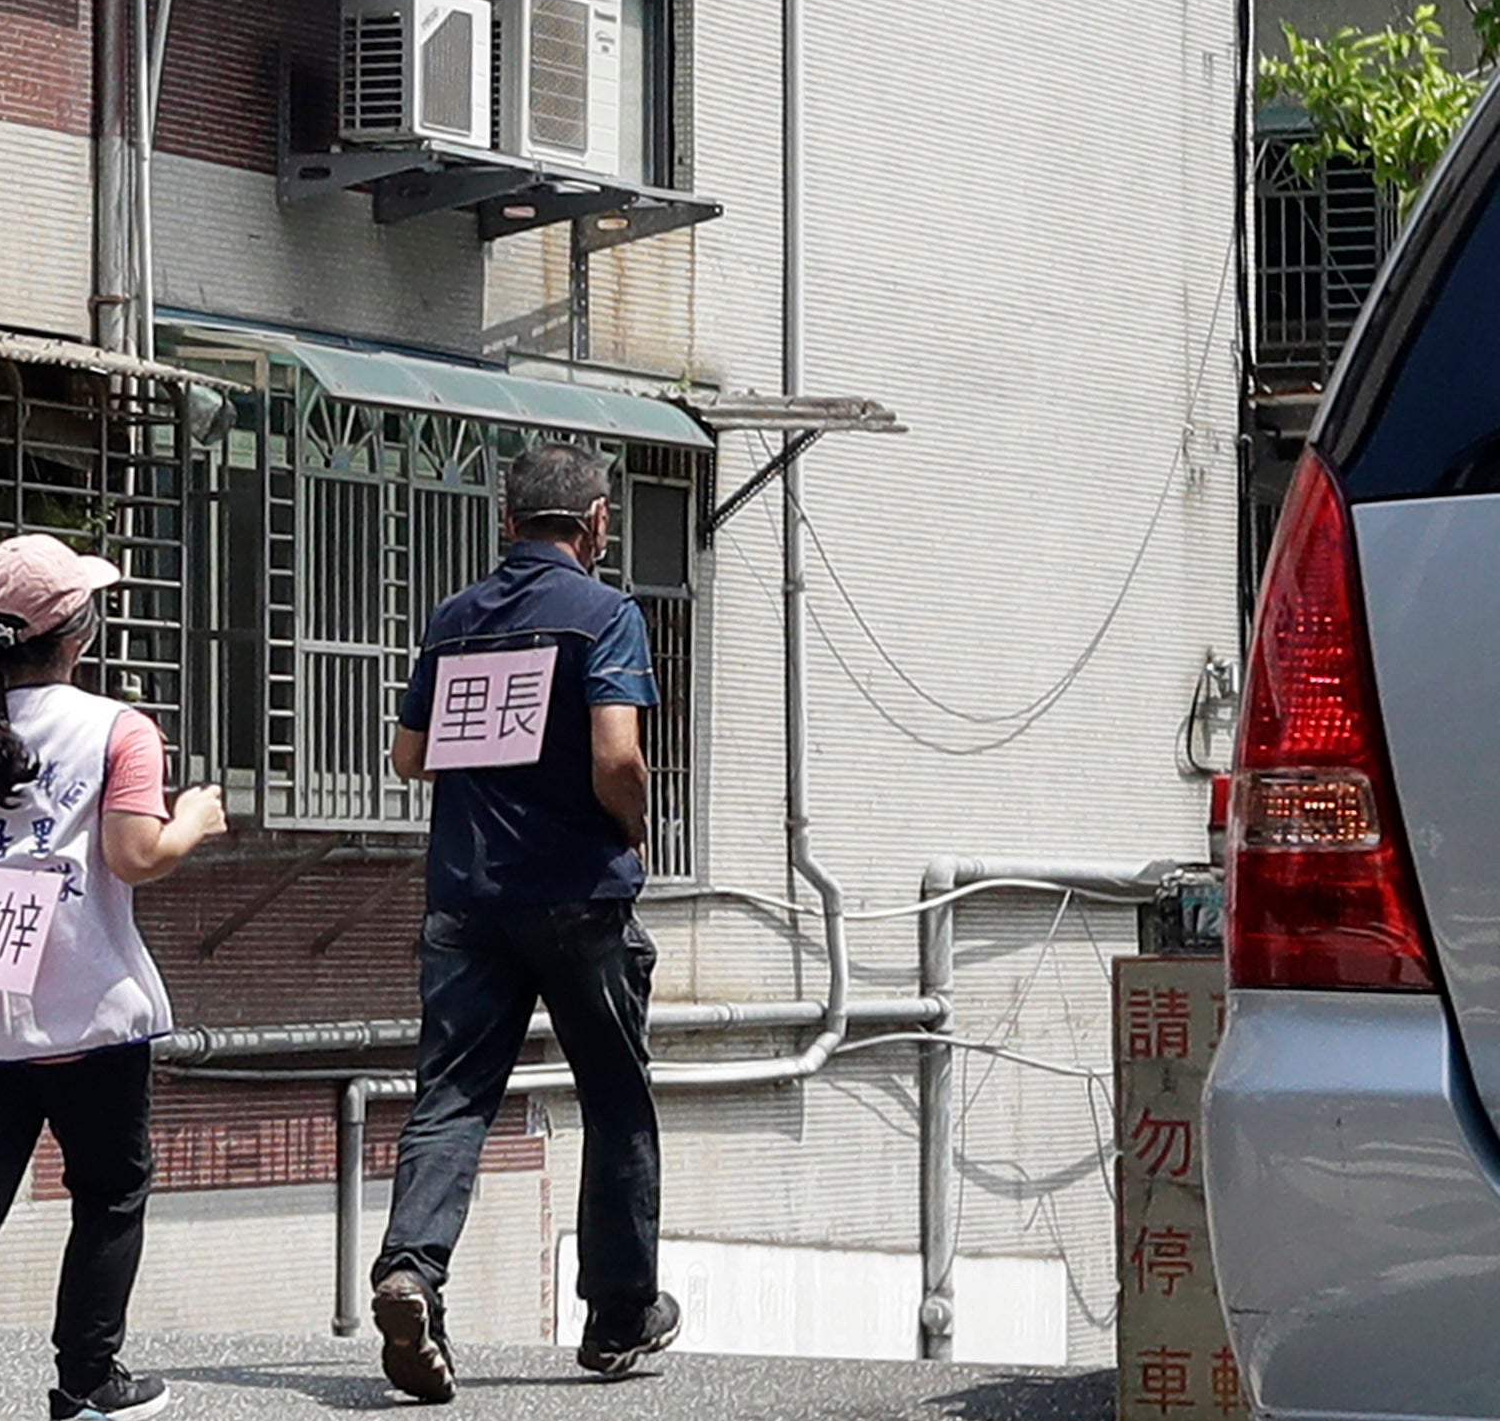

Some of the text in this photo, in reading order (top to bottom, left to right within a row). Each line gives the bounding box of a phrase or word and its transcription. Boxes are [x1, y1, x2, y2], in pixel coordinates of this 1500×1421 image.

[436, 669, 545, 743] 里長
[1126, 986, 1197, 1415] 請勿停車
